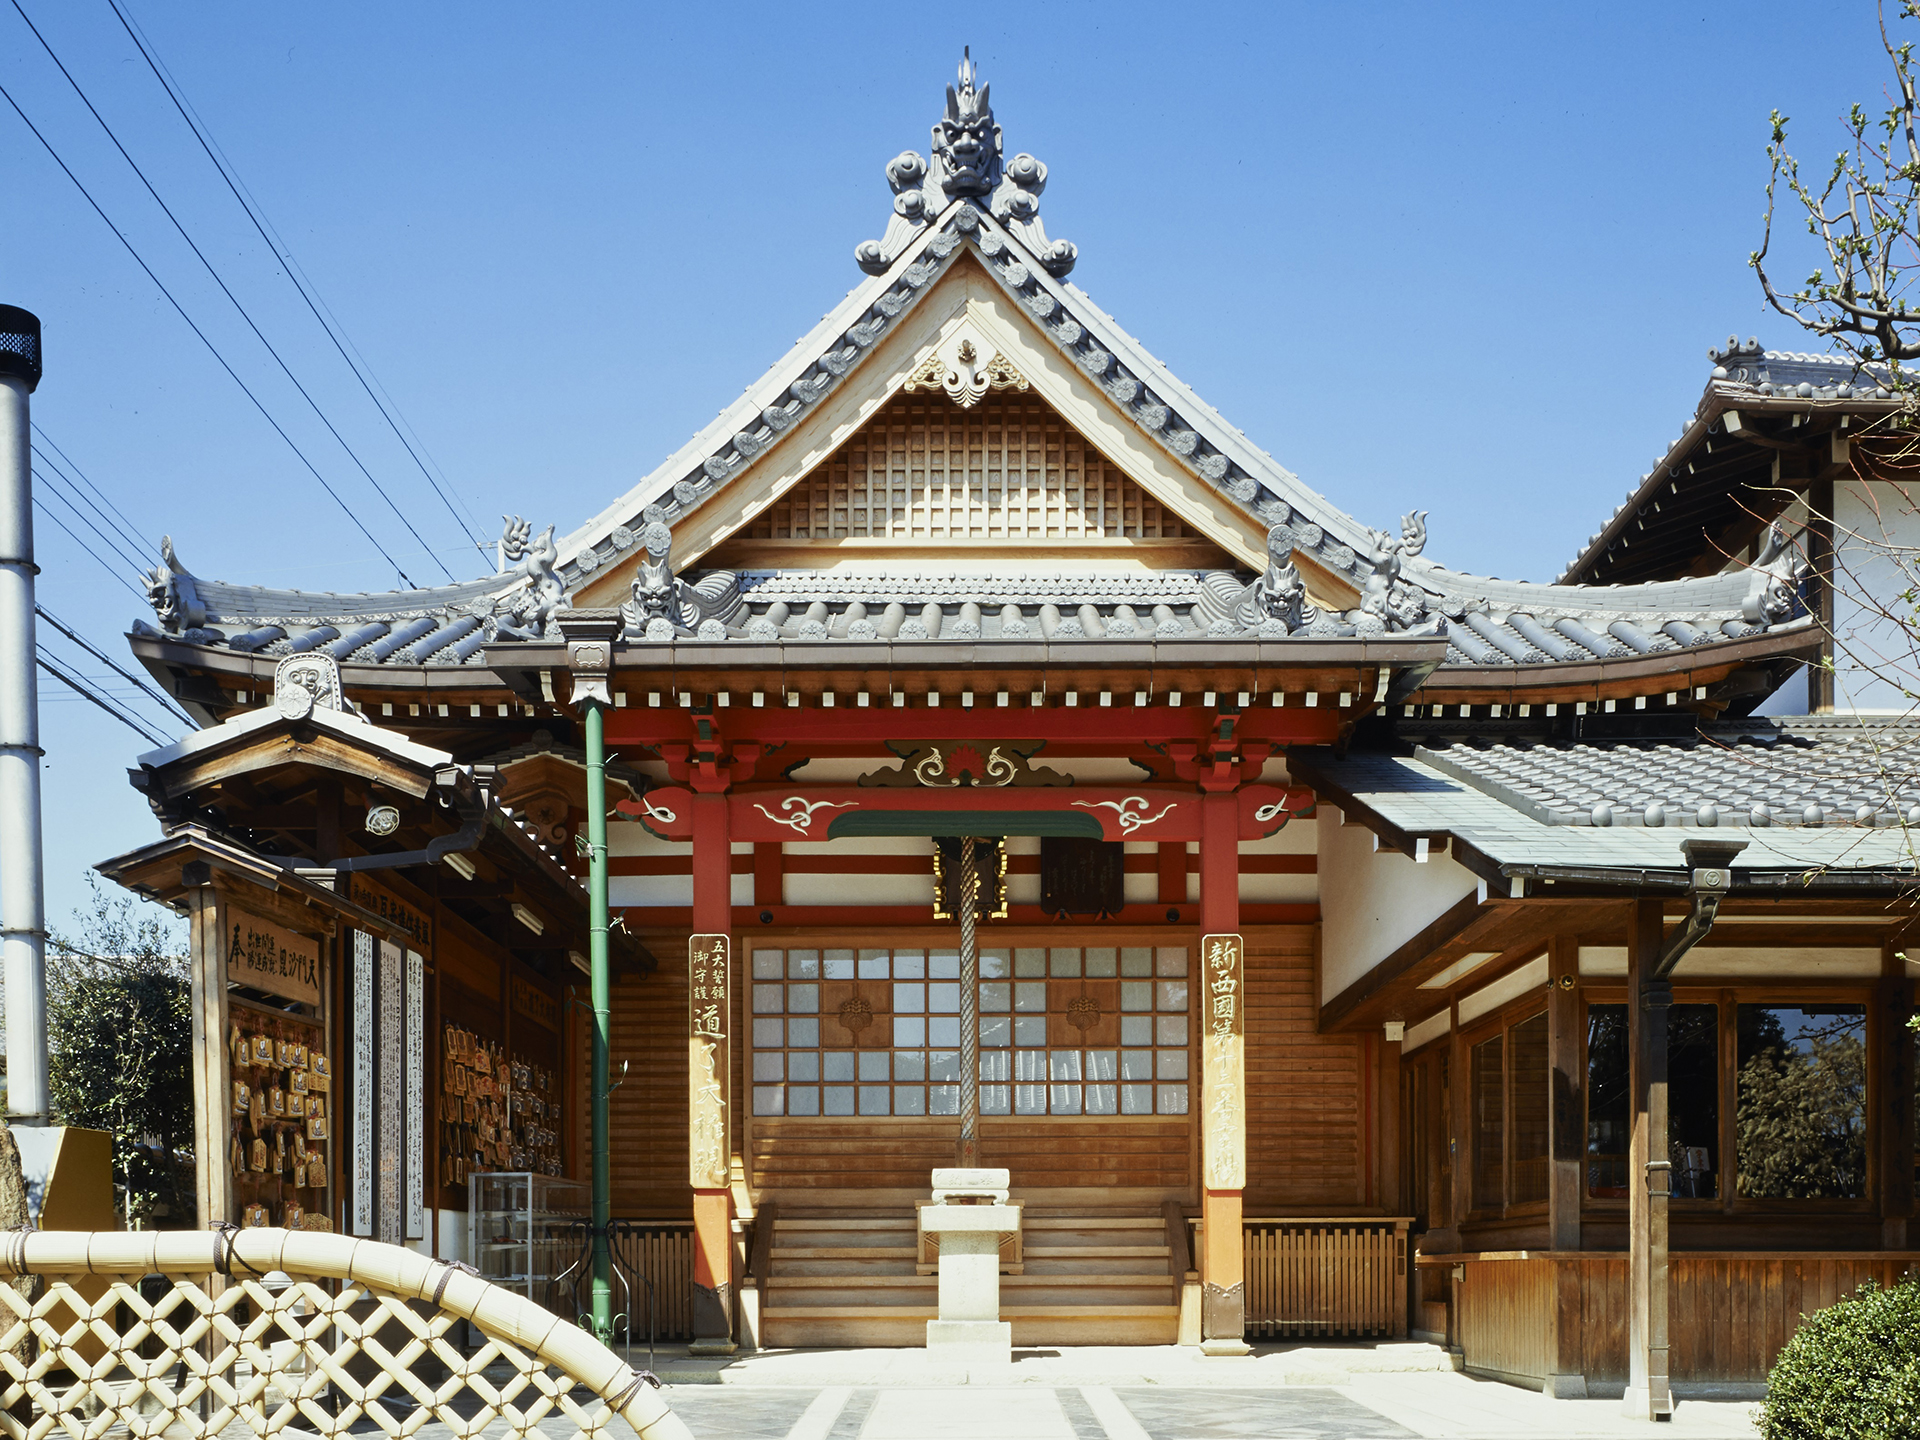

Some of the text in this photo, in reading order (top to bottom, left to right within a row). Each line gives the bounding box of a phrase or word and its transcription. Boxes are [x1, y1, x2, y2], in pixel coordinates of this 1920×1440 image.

[228, 922, 247, 971] 奉
[279, 946, 319, 990] 毘沙門天
[711, 940, 726, 1000] 五大誓願
[693, 950, 709, 1000] 御守護
